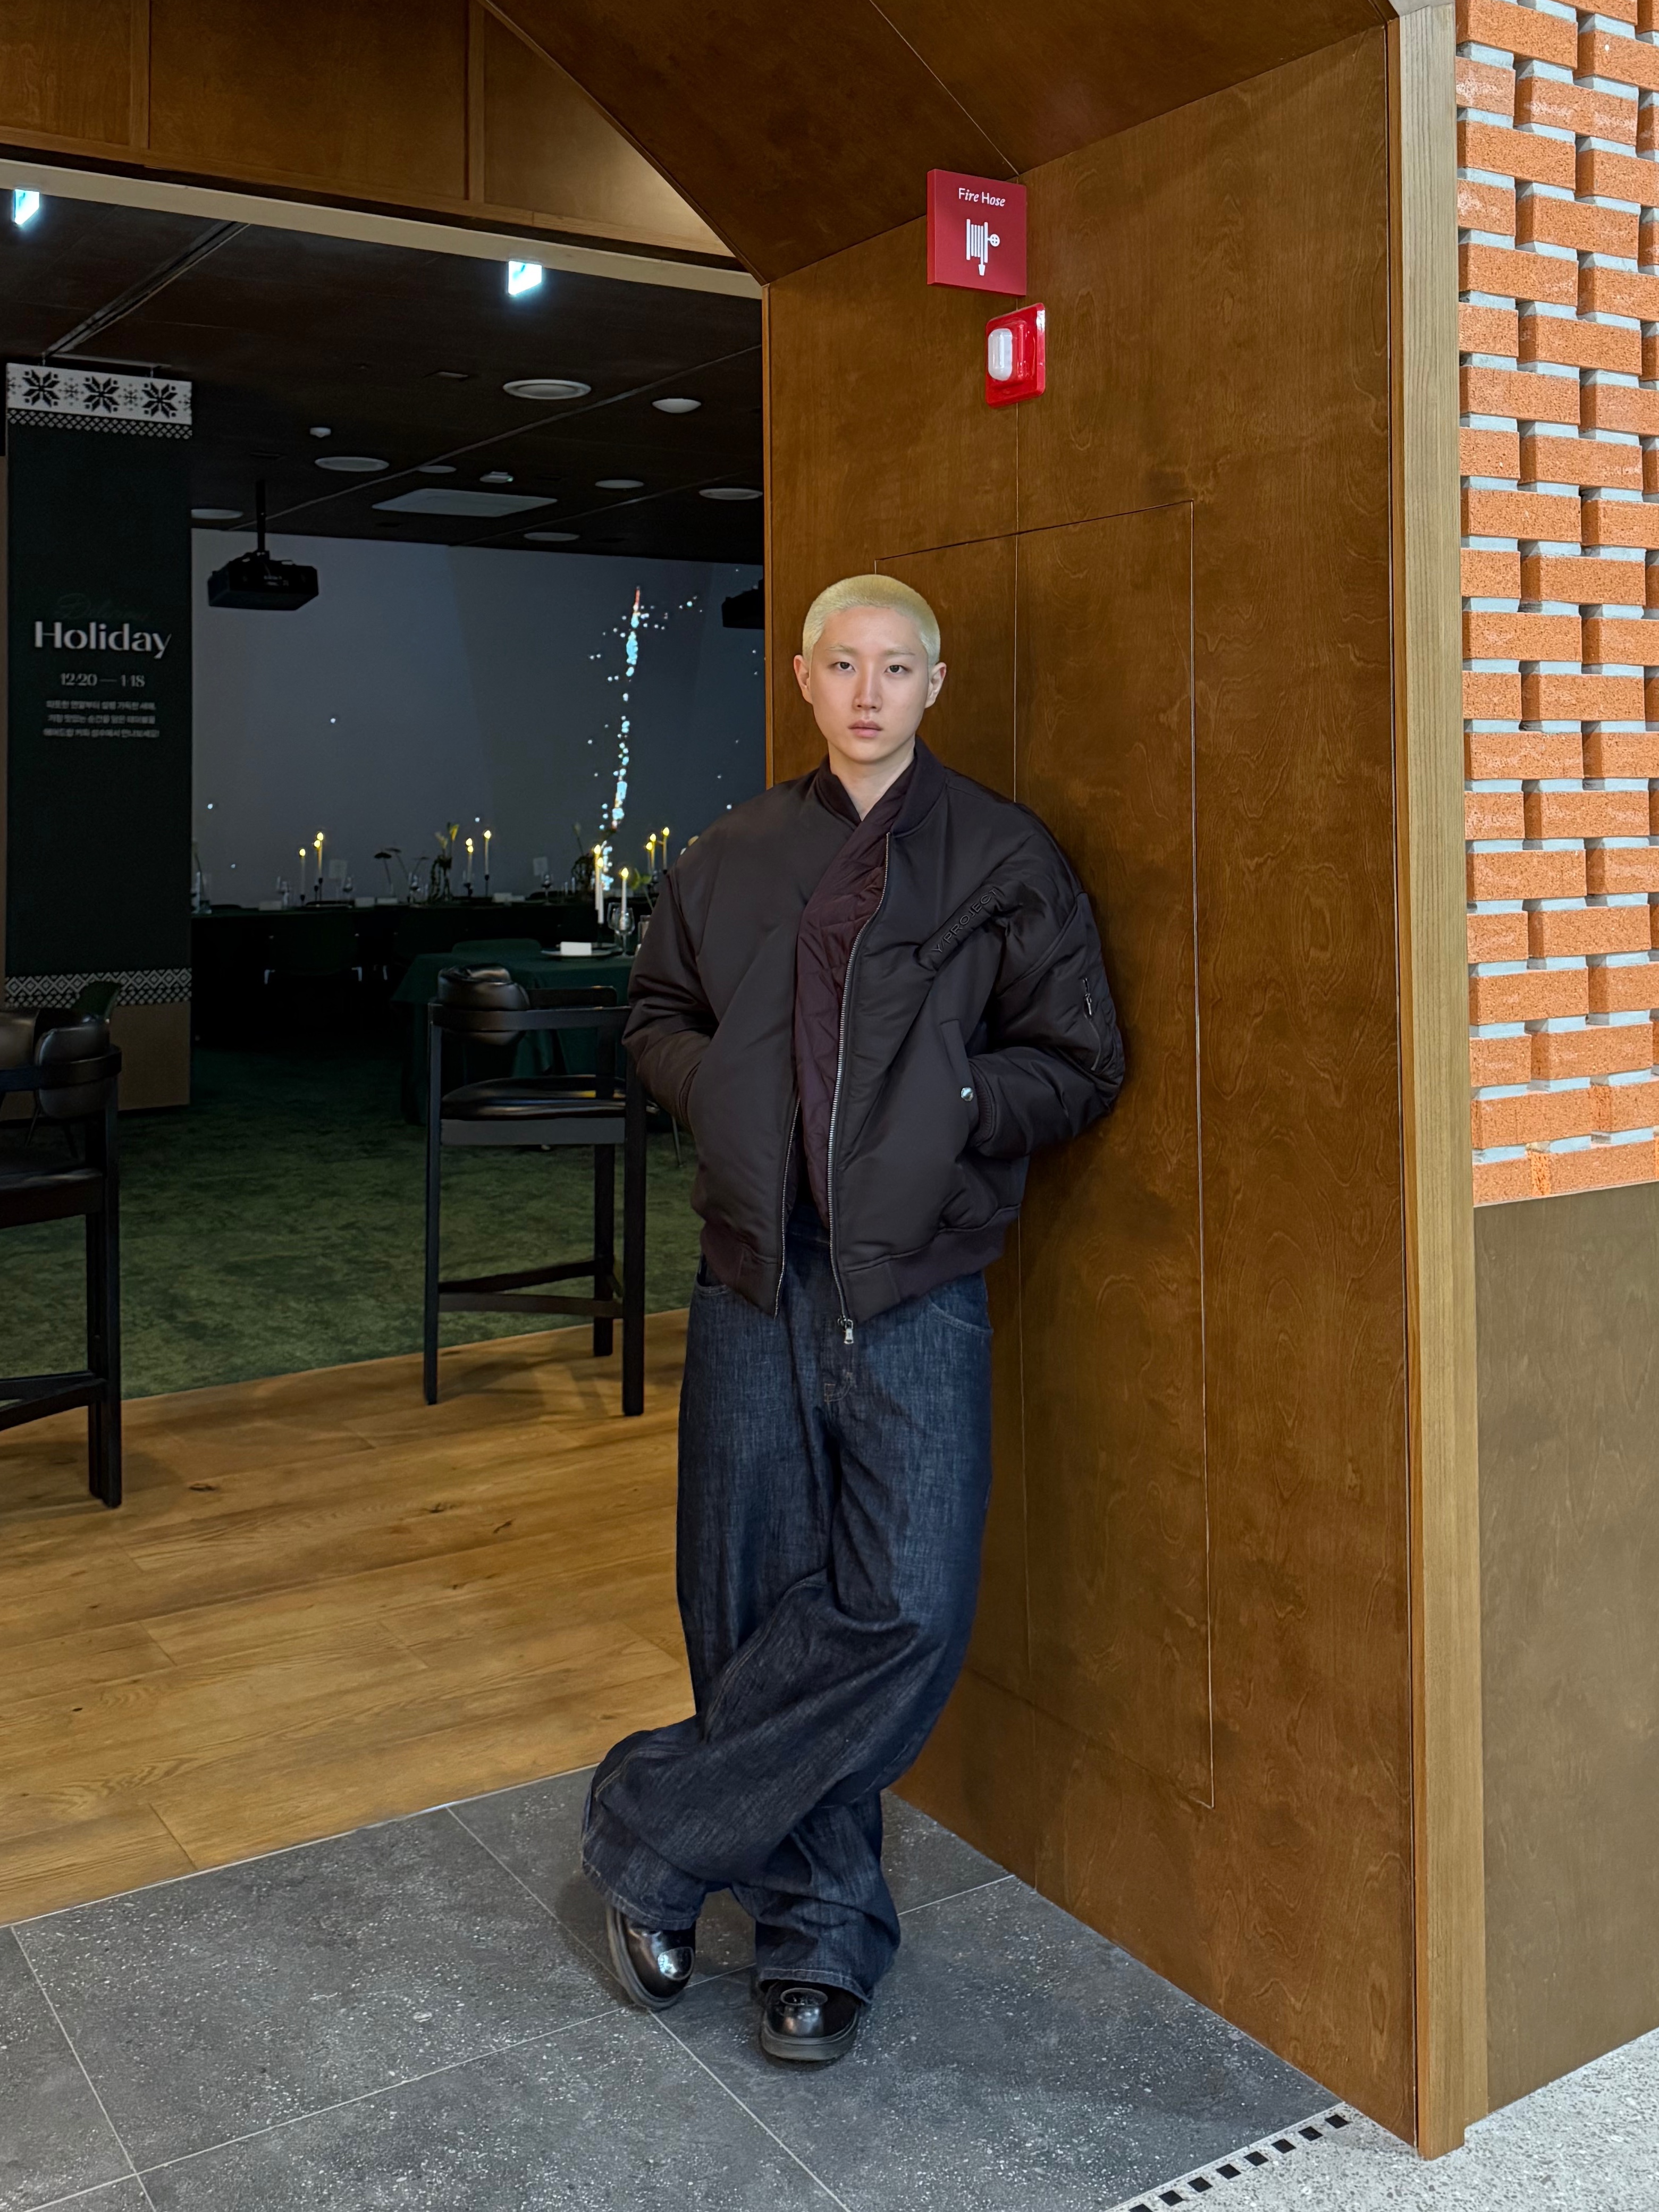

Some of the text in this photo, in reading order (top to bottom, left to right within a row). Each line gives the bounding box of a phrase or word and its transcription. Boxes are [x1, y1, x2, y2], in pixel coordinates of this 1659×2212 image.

[958, 187, 1006, 207] Fire Hose
[35, 621, 172, 659] Holiday
